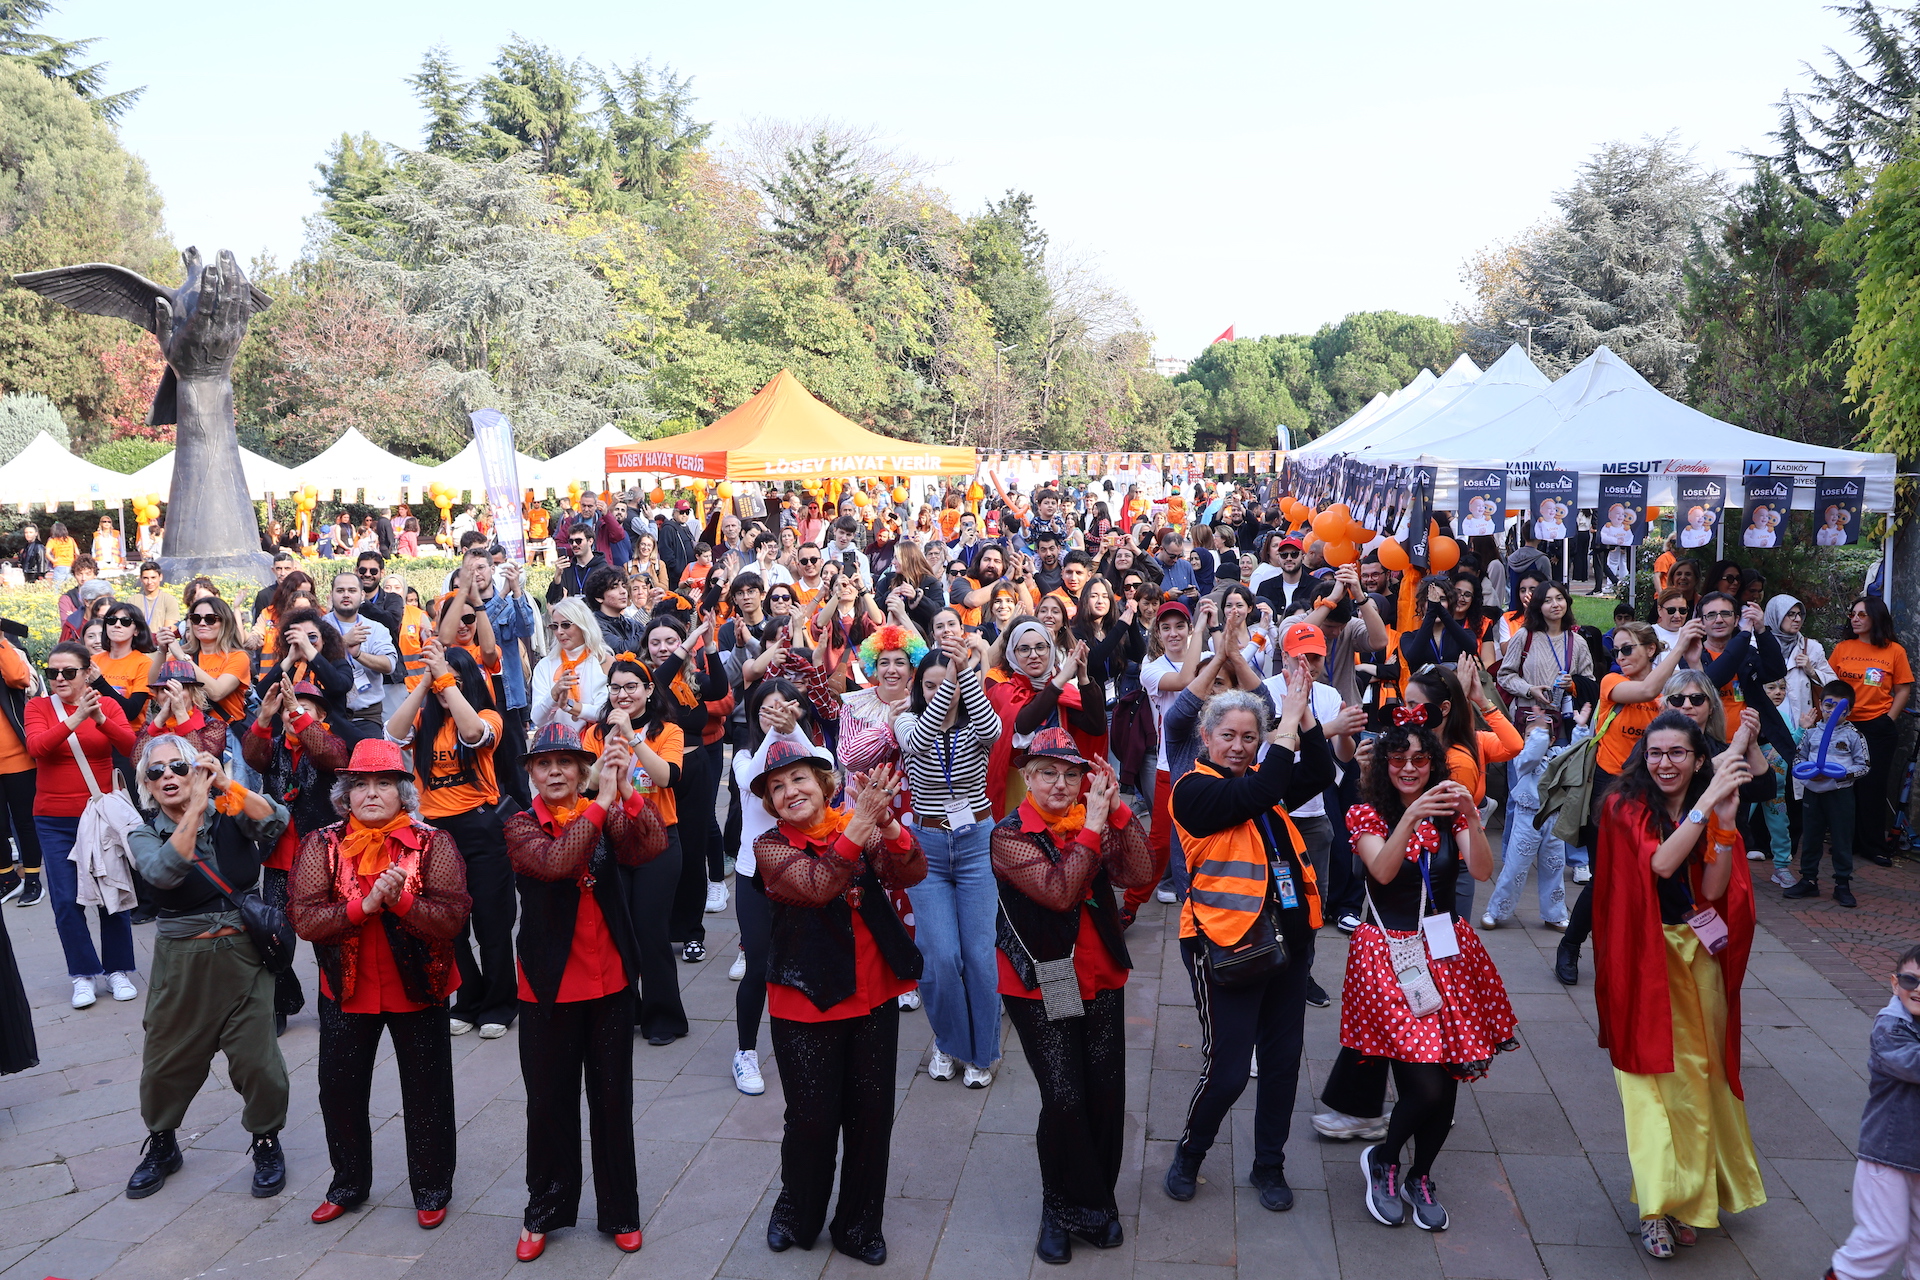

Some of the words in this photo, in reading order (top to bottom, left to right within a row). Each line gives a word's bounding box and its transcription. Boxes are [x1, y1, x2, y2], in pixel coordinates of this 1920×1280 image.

[645, 452, 674, 467] HAYAT
[675, 454, 705, 472] VERİR
[764, 457, 826, 474] LÖSEV
[831, 455, 887, 471] HAYAT
[892, 452, 942, 470] VERİR
[1506, 460, 1557, 475] KADIKÖY
[1602, 460, 1662, 474] MESUT
[1776, 463, 1808, 472] KADIKÖY
[1464, 479, 1489, 487] LÖSEV
[1536, 481, 1561, 489] LÖSEV
[1605, 486, 1630, 494] LÖSEV
[1683, 488, 1709, 496] LÖSEV
[1821, 488, 1846, 496] LÖSEV
[1839, 671, 1864, 679] LÖSEV
